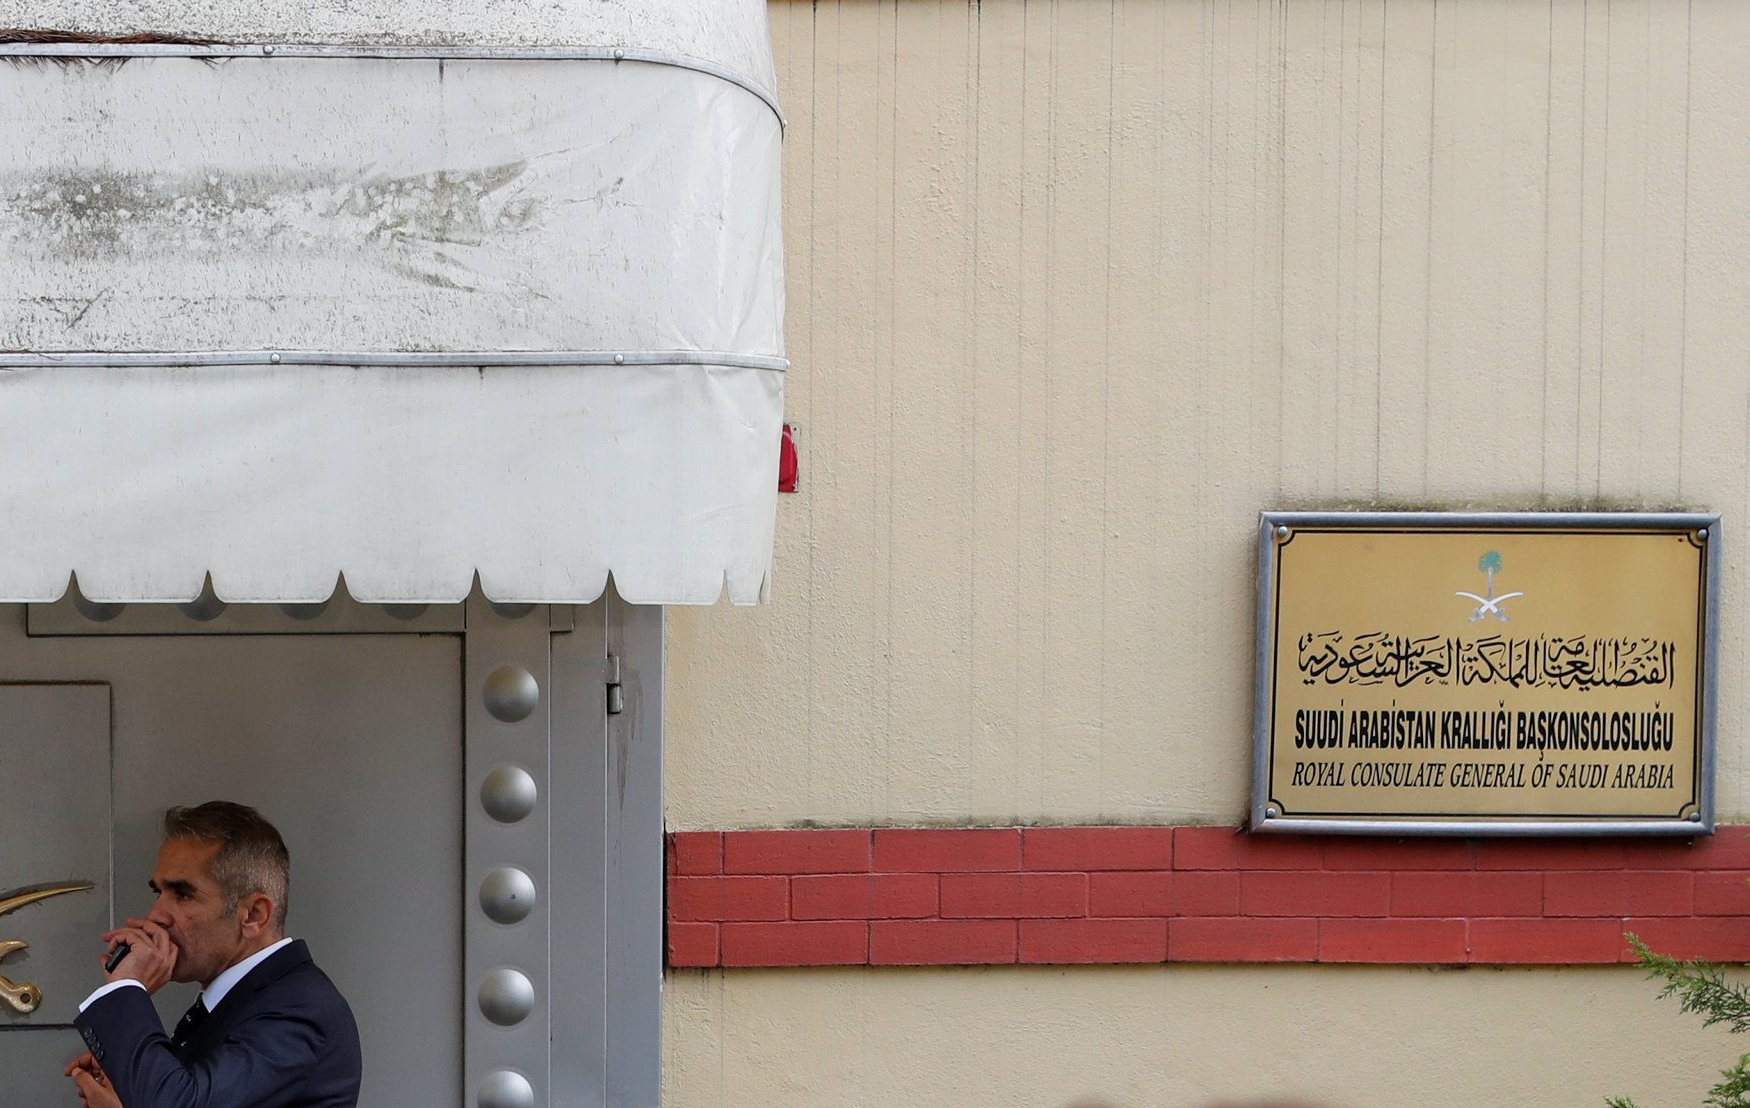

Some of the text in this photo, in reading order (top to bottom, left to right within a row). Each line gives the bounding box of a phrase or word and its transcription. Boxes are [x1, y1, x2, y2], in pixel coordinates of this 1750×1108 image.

[1295, 699, 1674, 762] SUUDİ ARABİSTAN KRALLIĞI BAŞKONSOLOSLUĞU
[1291, 761, 1674, 789] ROYAL CONSULATE GENERAL OF SAUDI ARABIA
